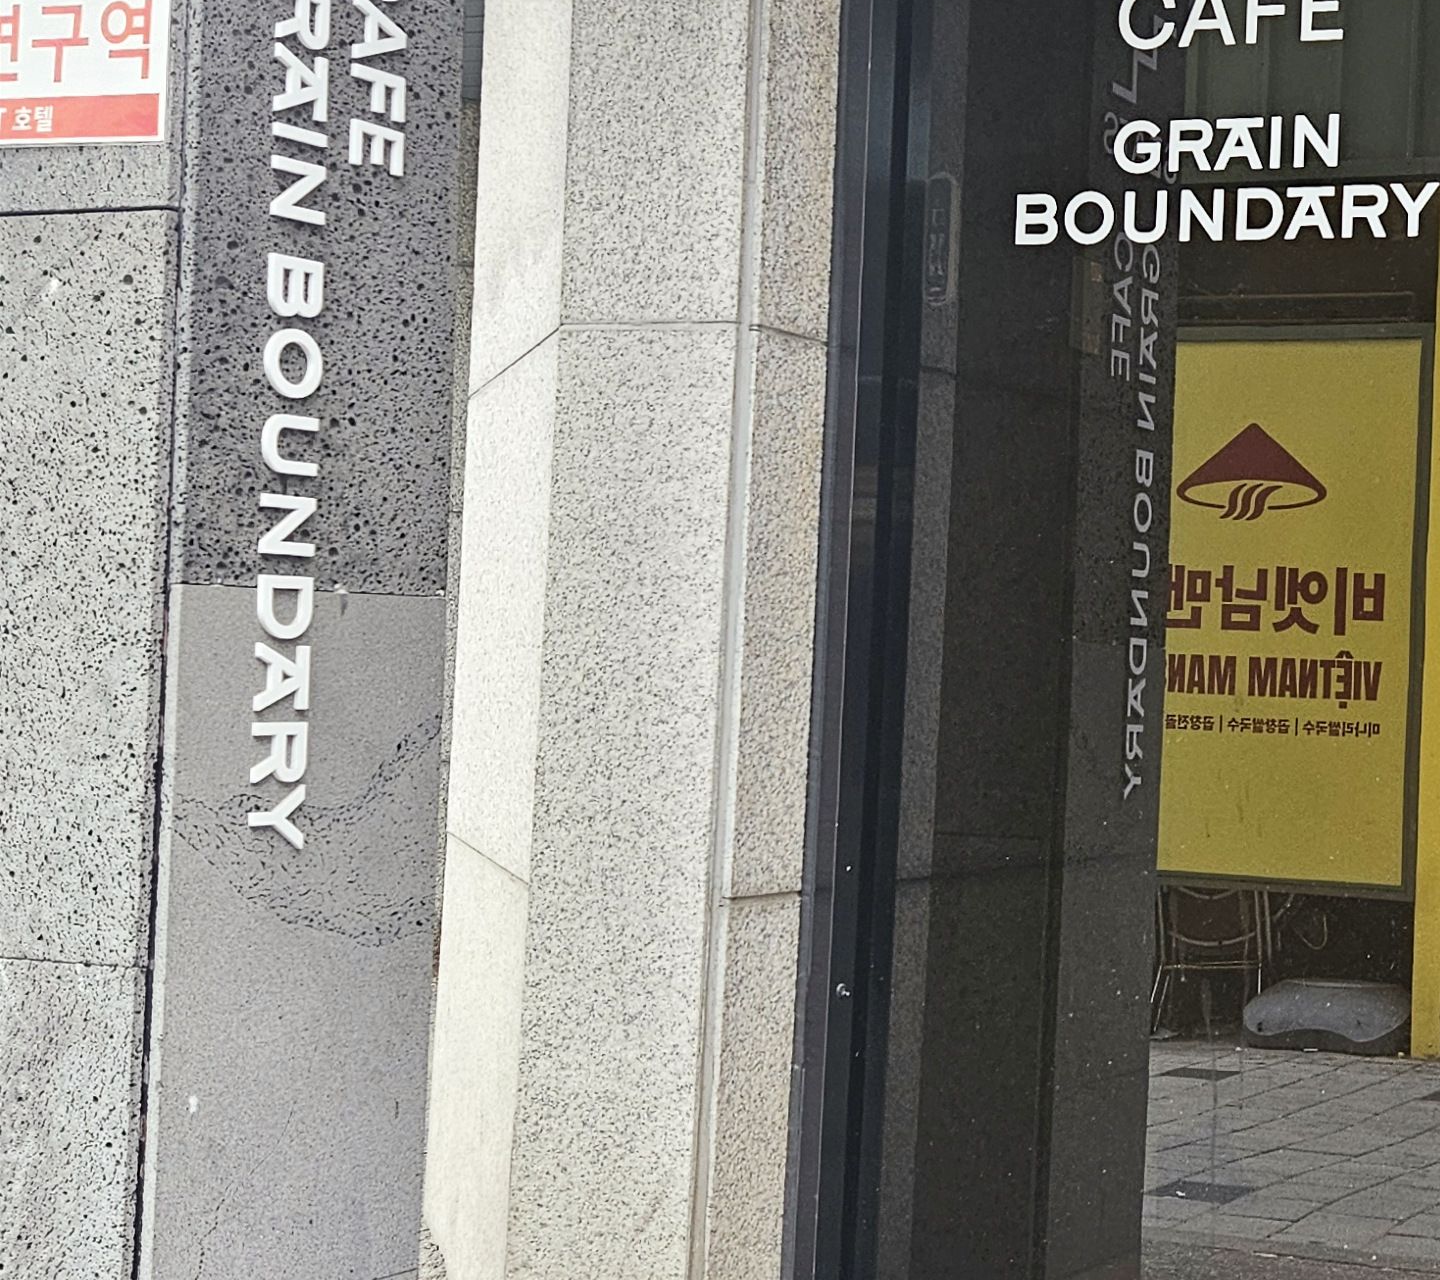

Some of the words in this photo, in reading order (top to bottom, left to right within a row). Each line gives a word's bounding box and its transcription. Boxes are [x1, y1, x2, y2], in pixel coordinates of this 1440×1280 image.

[12, 106, 53, 133] 호텔
[1113, 113, 1340, 175] GRAIN
[1015, 182, 1440, 245] BOUNDARY
[248, 251, 325, 851] BOUNDARY
